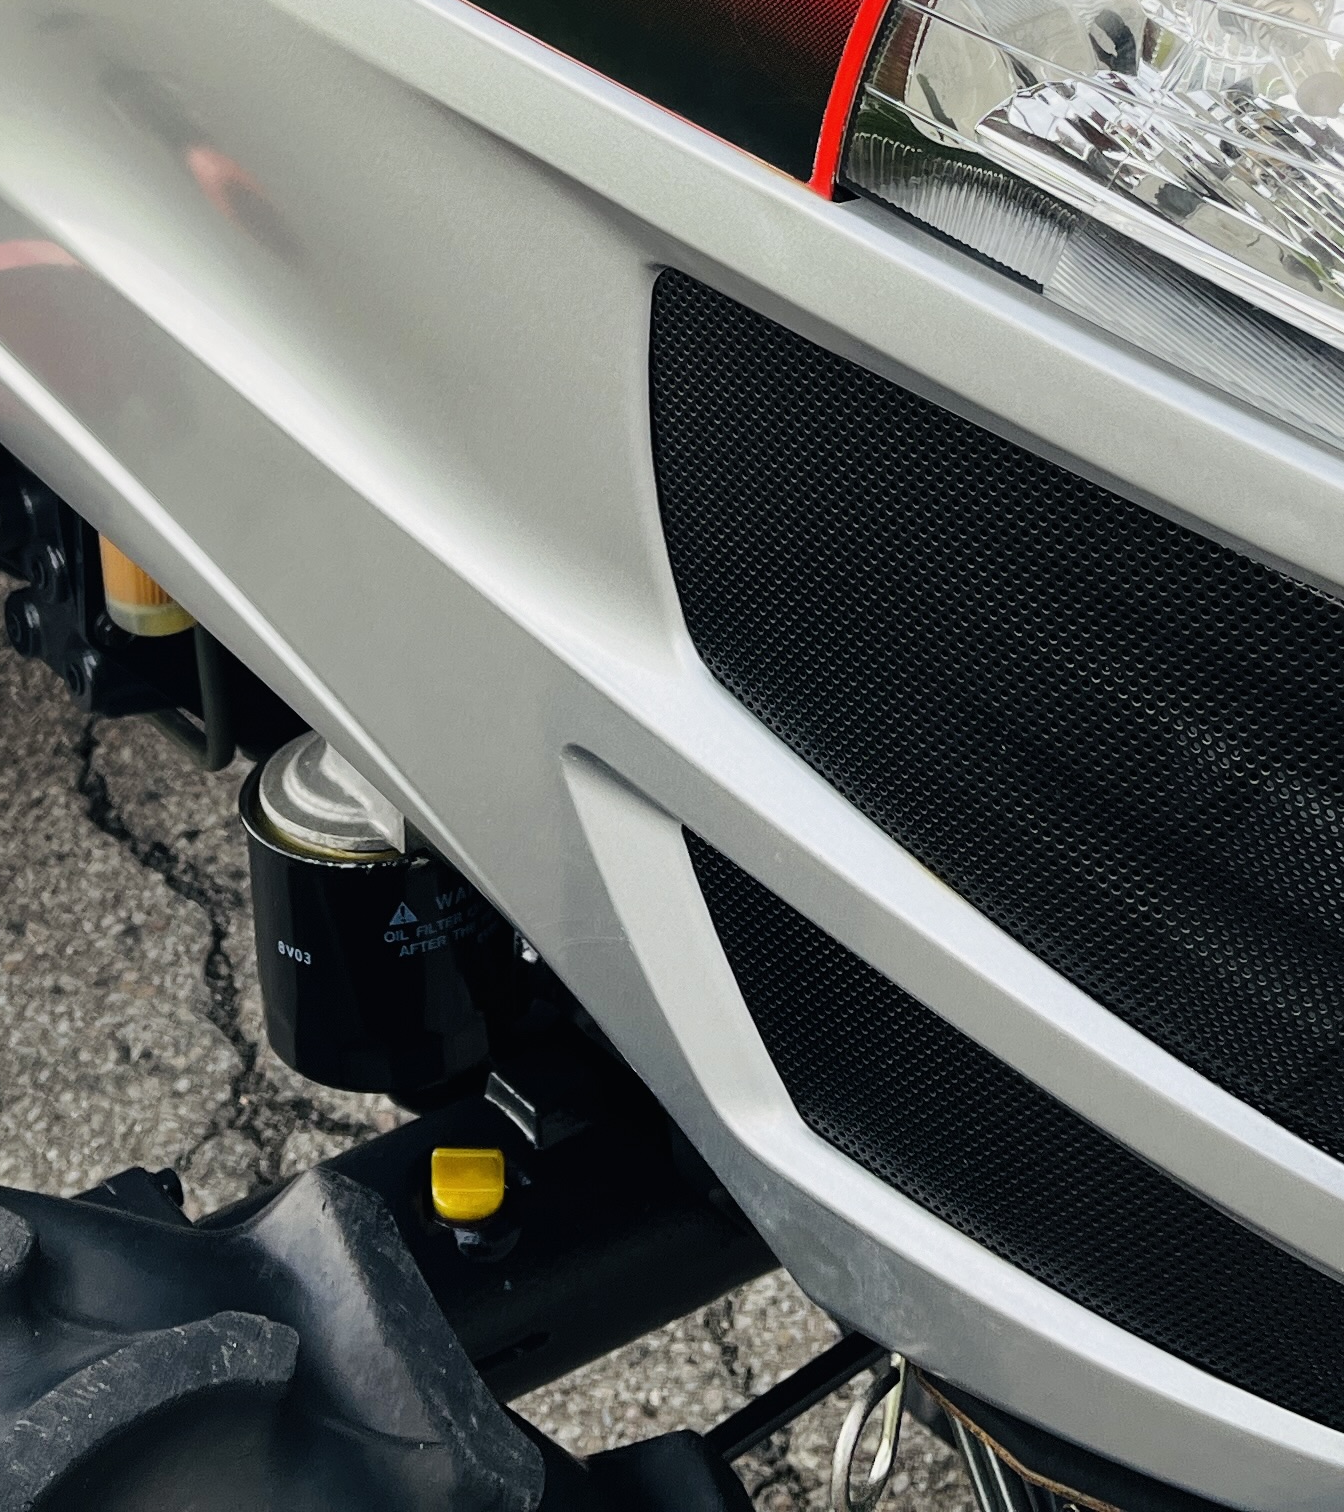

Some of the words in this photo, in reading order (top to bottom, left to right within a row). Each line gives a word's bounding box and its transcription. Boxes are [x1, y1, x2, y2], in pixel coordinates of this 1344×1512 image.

[383, 929, 409, 943] OIL
[416, 912, 463, 937] FILTER
[277, 940, 311, 965] 8V03
[399, 935, 448, 958] AFTER
